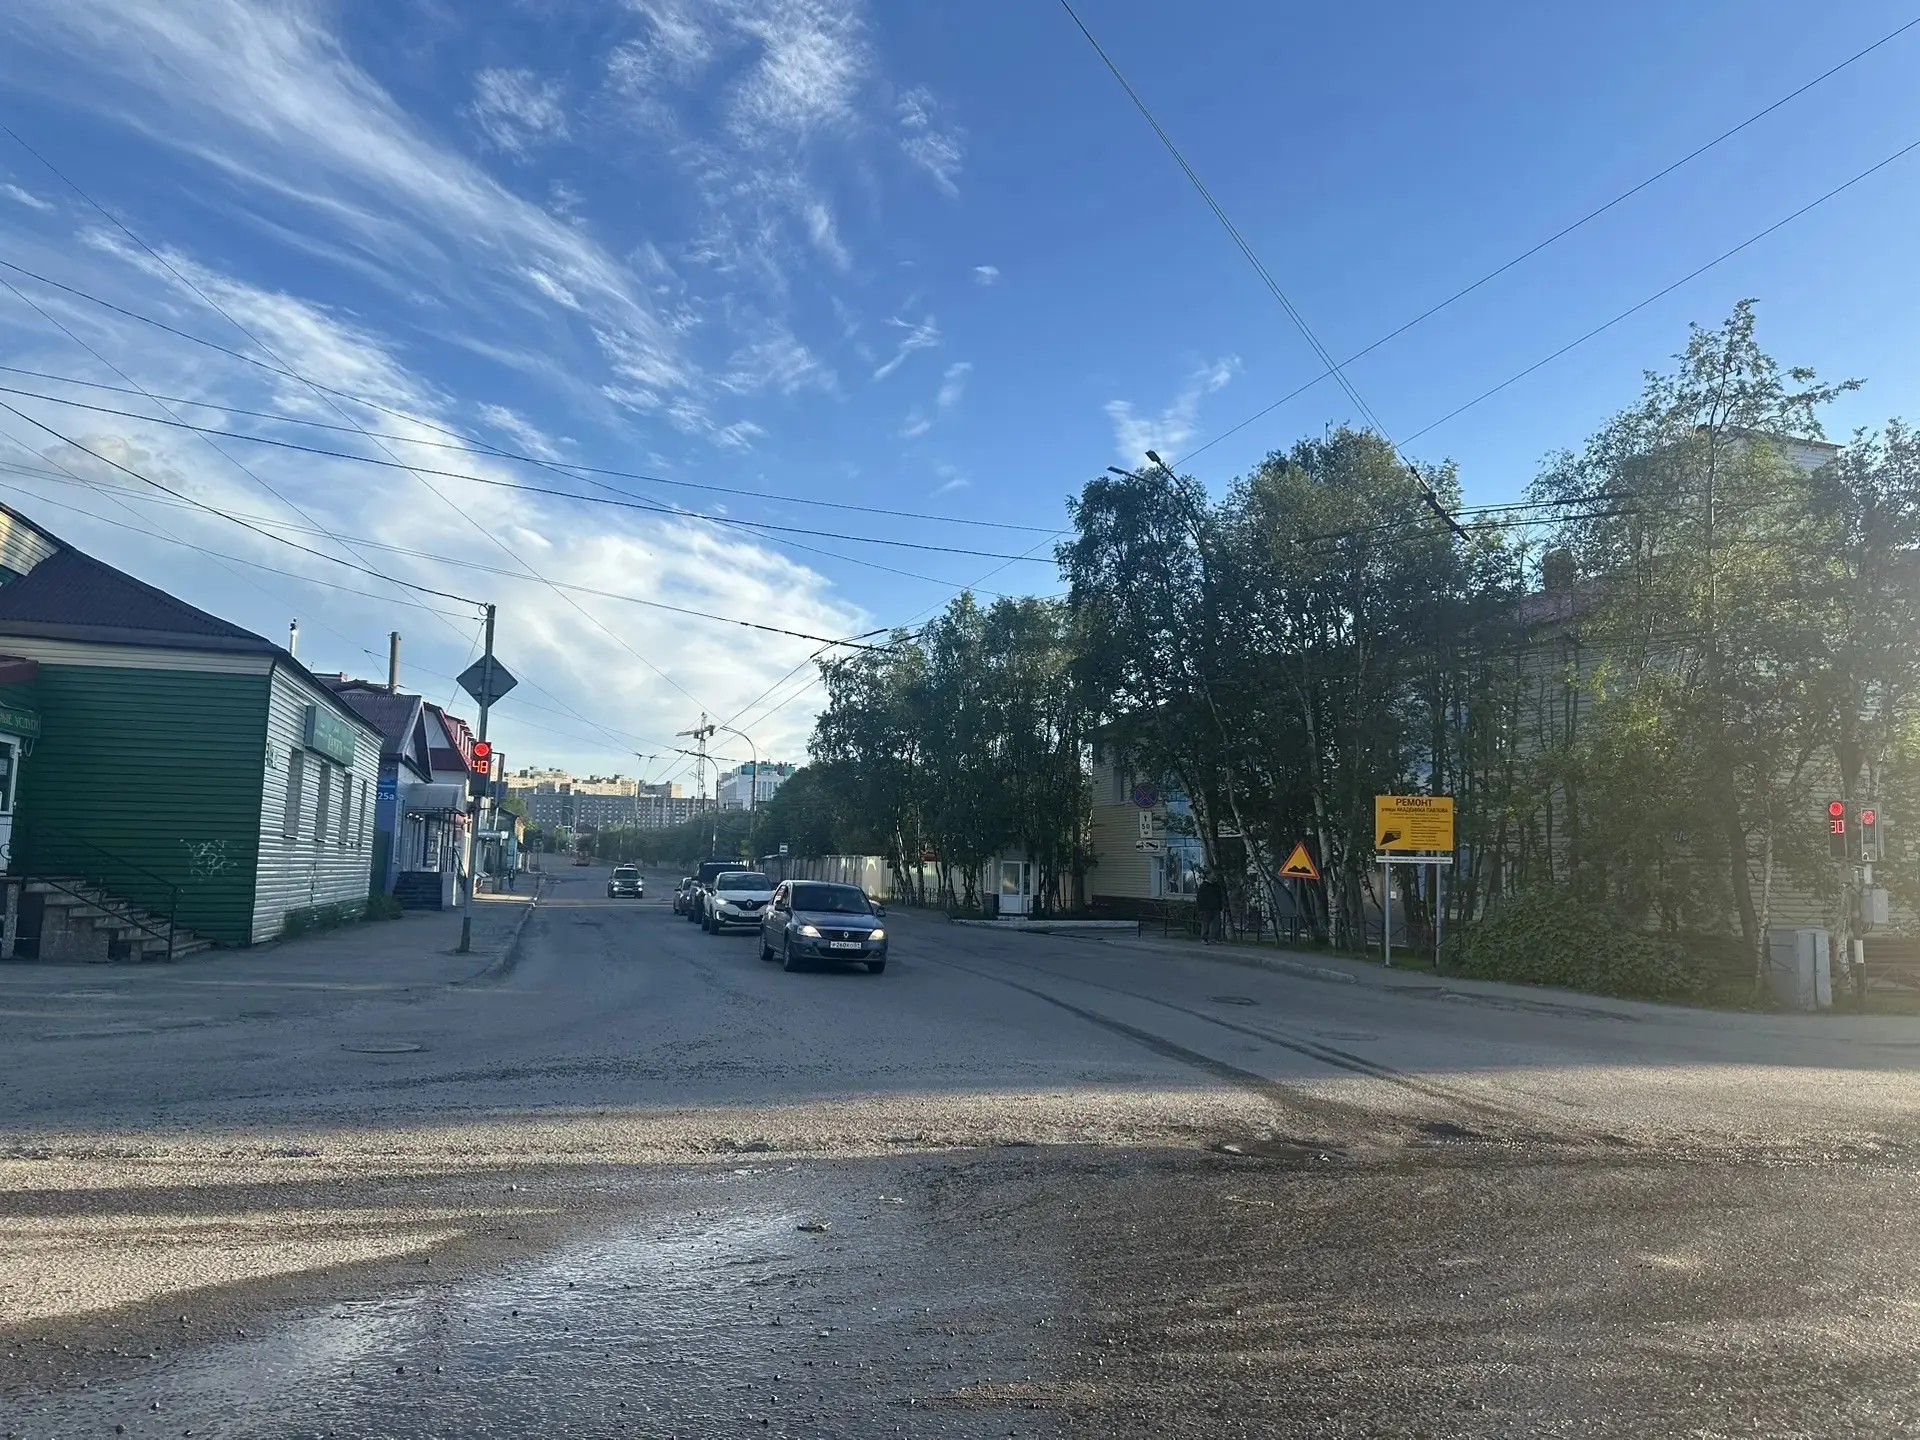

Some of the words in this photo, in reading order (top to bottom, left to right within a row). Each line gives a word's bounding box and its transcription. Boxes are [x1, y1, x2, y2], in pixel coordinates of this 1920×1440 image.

[472, 760, 489, 774] 48
[1395, 798, 1433, 807] РЕМОНТ
[1830, 819, 1845, 834] 30
